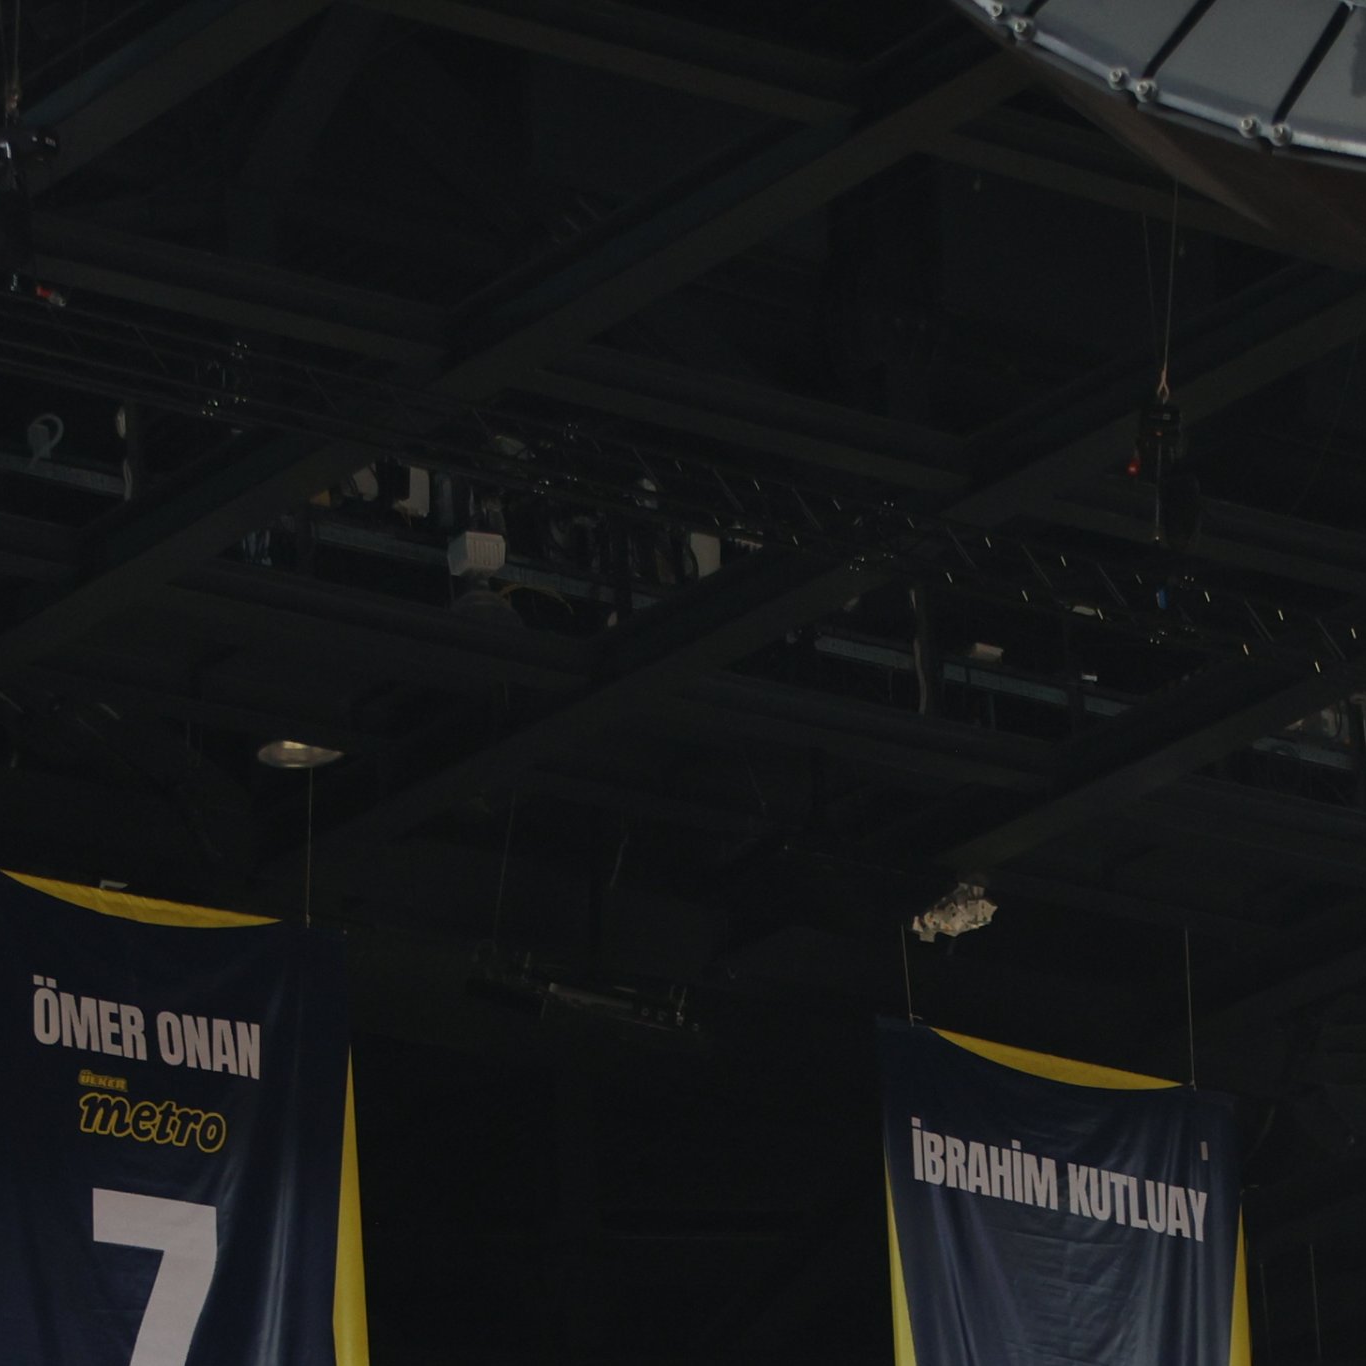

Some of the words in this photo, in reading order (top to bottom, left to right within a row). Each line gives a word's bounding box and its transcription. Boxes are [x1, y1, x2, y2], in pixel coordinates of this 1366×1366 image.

[33, 974, 147, 1062] ÖMER
[157, 1010, 261, 1081] ONAN
[79, 1091, 227, 1153] metro
[911, 1117, 1059, 1211] İBRAHİM
[1066, 1162, 1208, 1242] KUTLUAY
